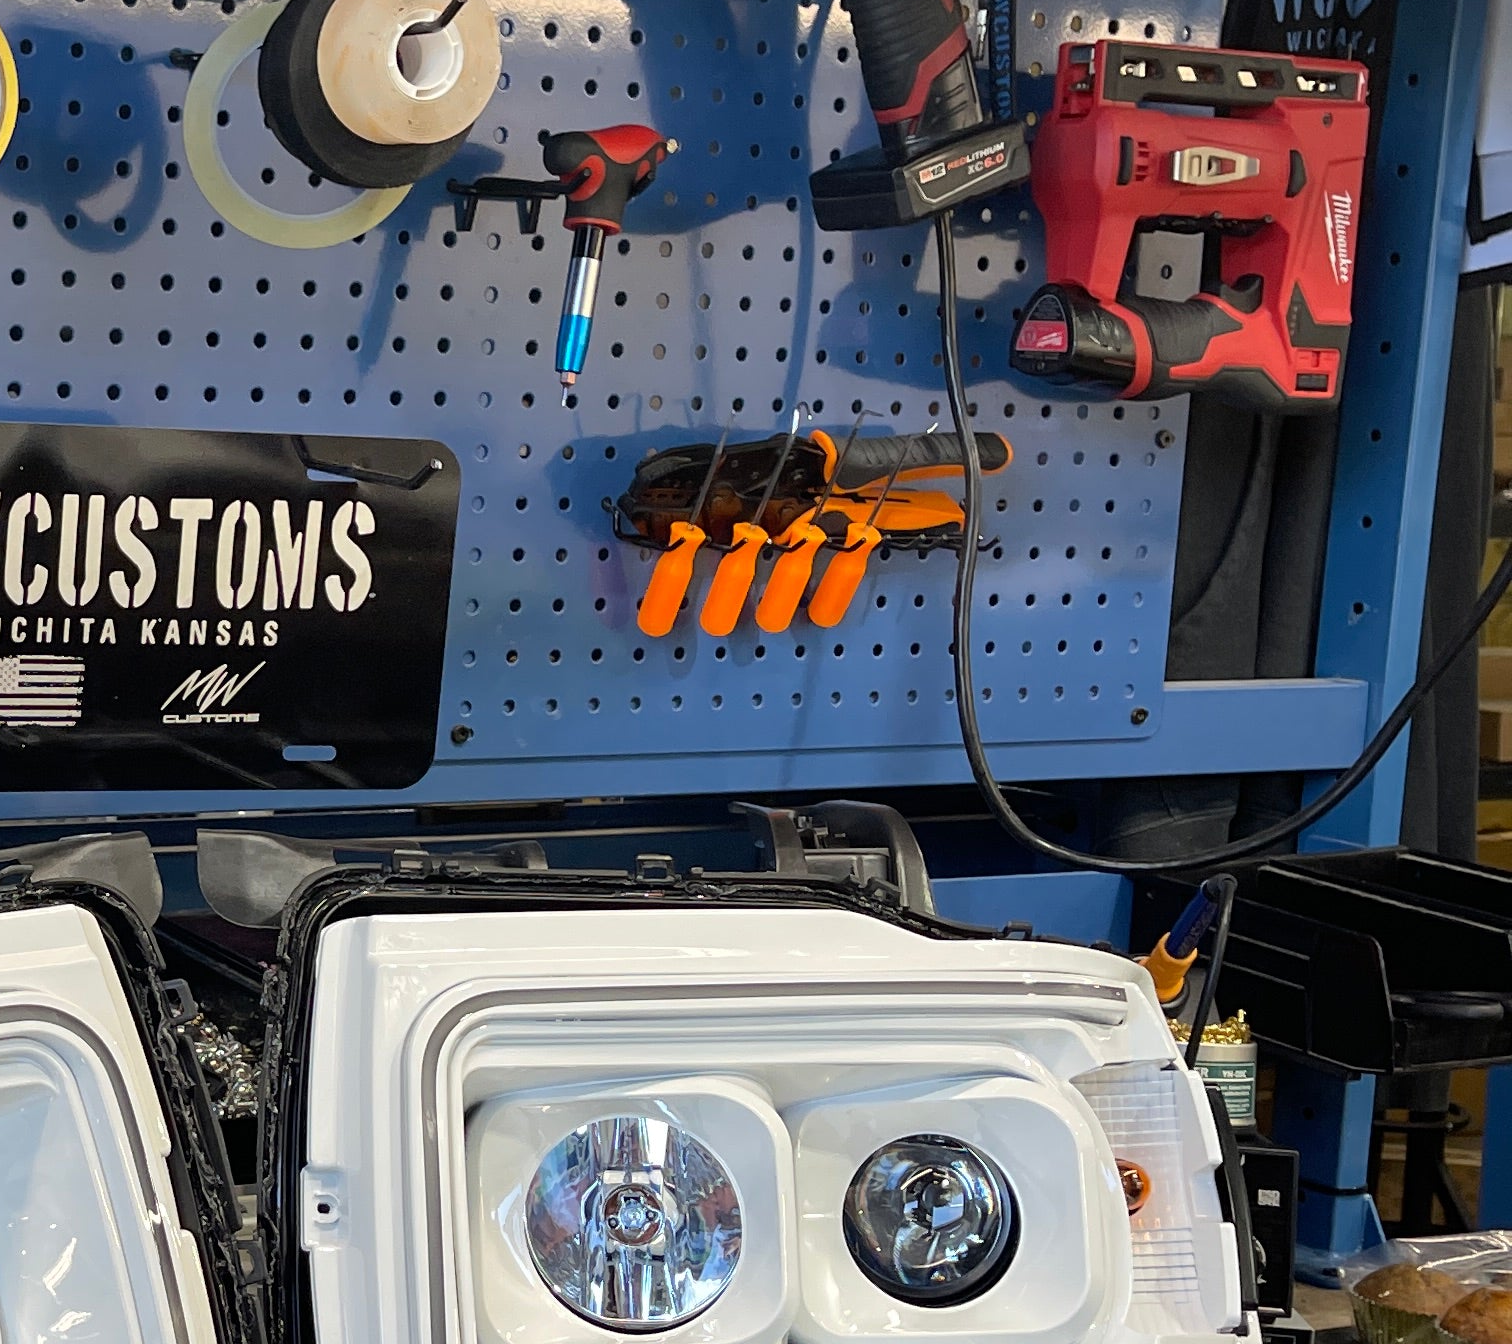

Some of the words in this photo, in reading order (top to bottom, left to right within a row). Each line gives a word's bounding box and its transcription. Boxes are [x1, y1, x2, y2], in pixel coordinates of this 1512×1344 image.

[947, 142, 1005, 171] REDLITHIUM
[1330, 189, 1352, 283] Milwaukee
[141, 618, 280, 647] KANSAS
[160, 660, 267, 712] MW
[162, 713, 260, 724] CUSTOMS
